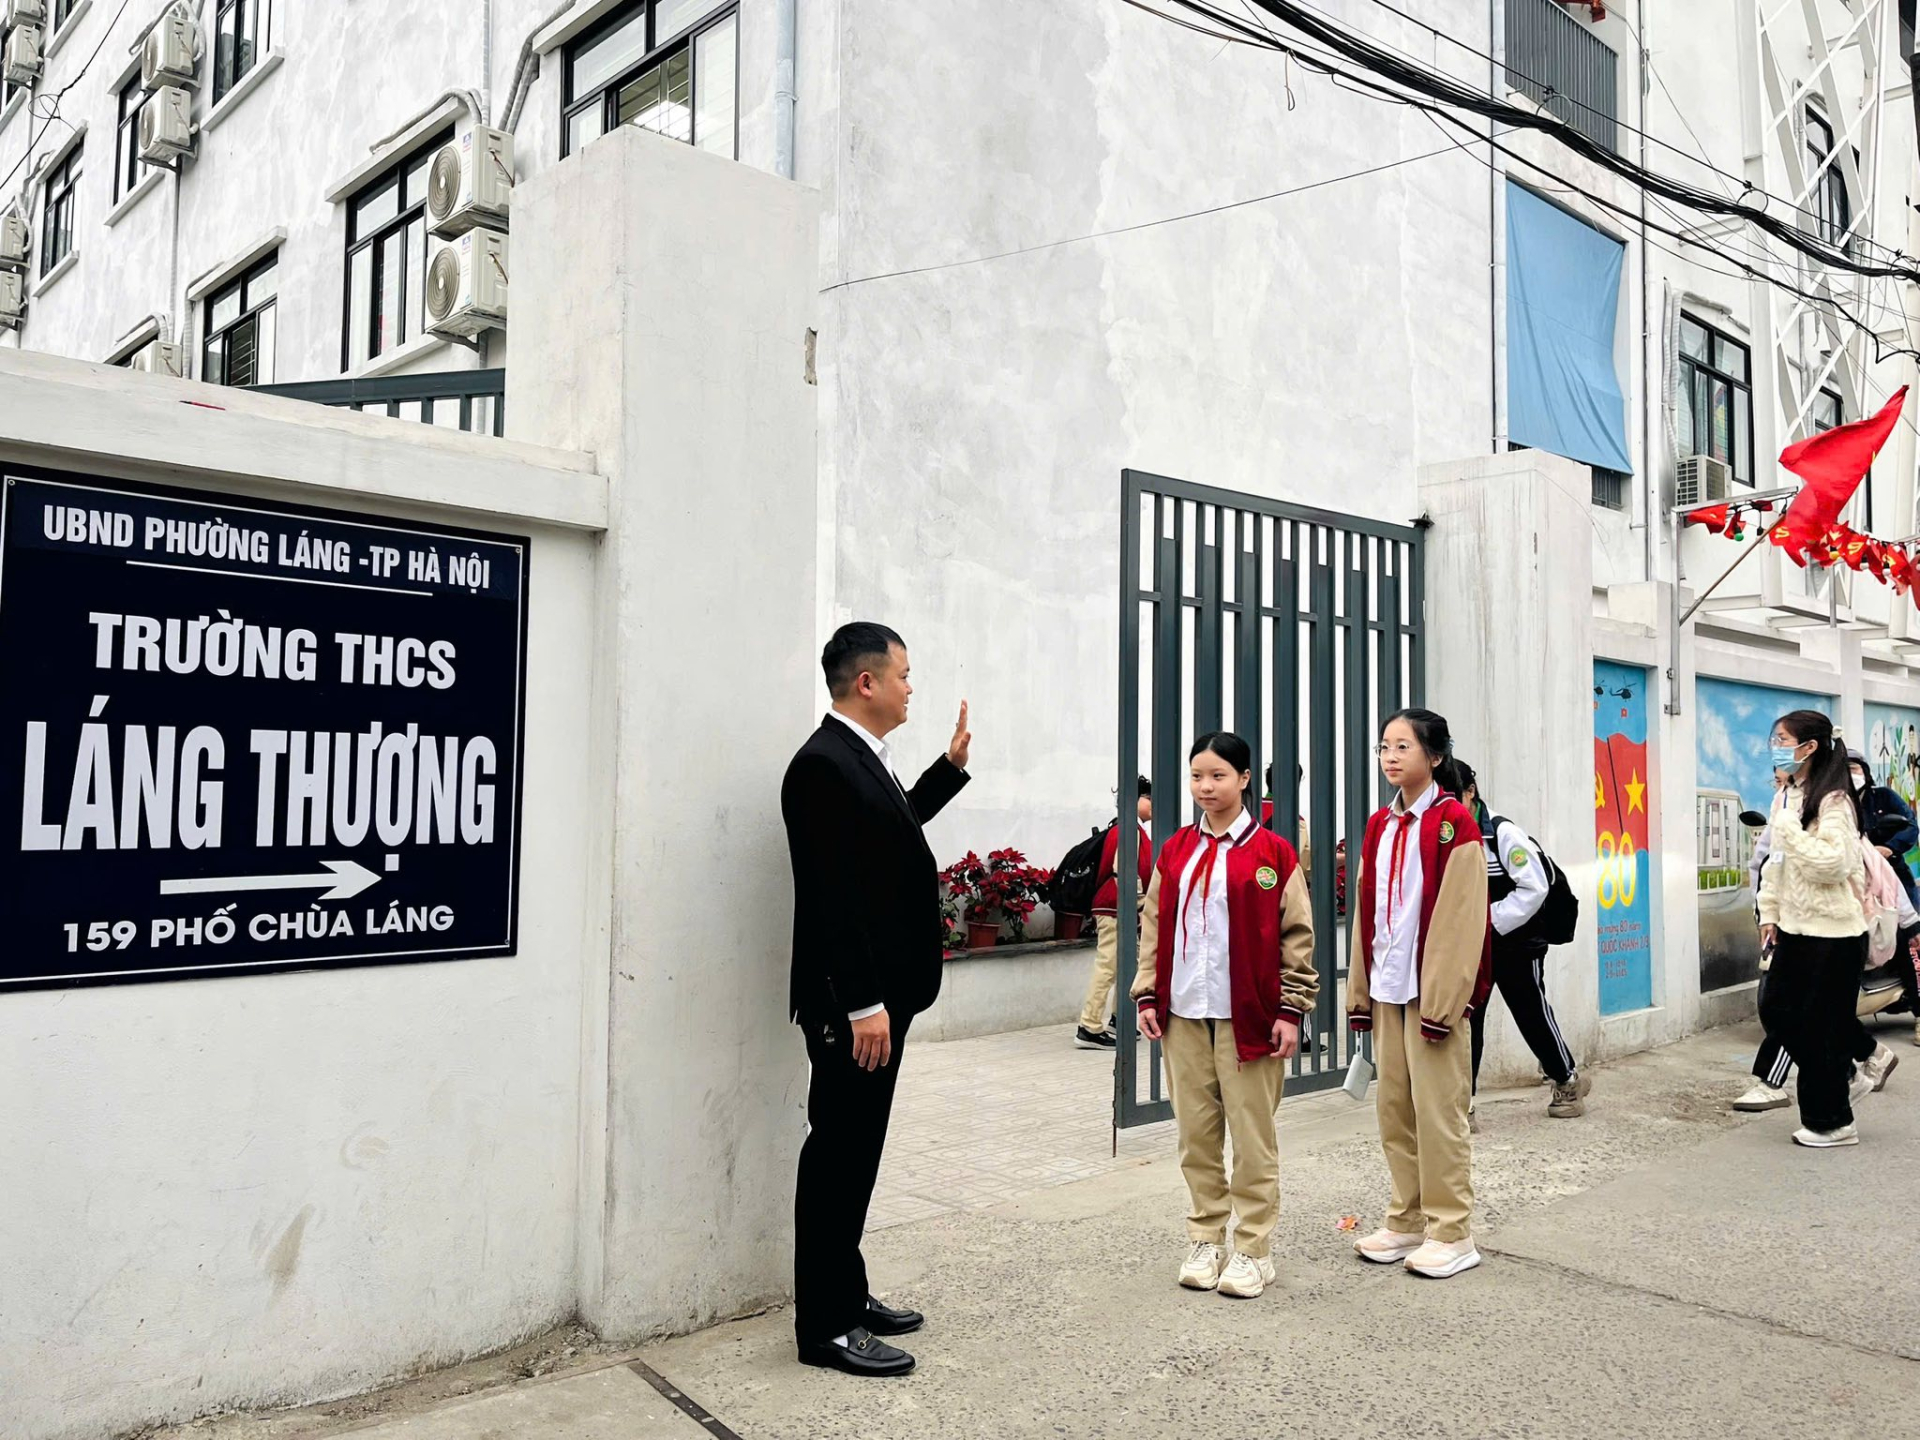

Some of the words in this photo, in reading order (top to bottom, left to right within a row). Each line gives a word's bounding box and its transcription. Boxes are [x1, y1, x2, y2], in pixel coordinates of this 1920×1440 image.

[44, 505, 133, 548] UBND
[145, 517, 269, 564] PHƯỜNG
[279, 530, 350, 573] LÁNG
[359, 546, 400, 577] -TP
[408, 547, 441, 584] HÀ
[449, 552, 490, 593] NỘI
[89, 609, 317, 682] TRƯỜNG
[335, 633, 456, 690] THCS
[21, 695, 225, 851] LÁNG
[250, 721, 497, 872] THƯỢNG
[1597, 830, 1637, 909] 80
[64, 920, 137, 952] 159
[151, 903, 237, 948] PHỐ
[249, 904, 354, 942] CHÙA
[367, 899, 455, 934] LÁNG
[1620, 920, 1628, 932] 80
